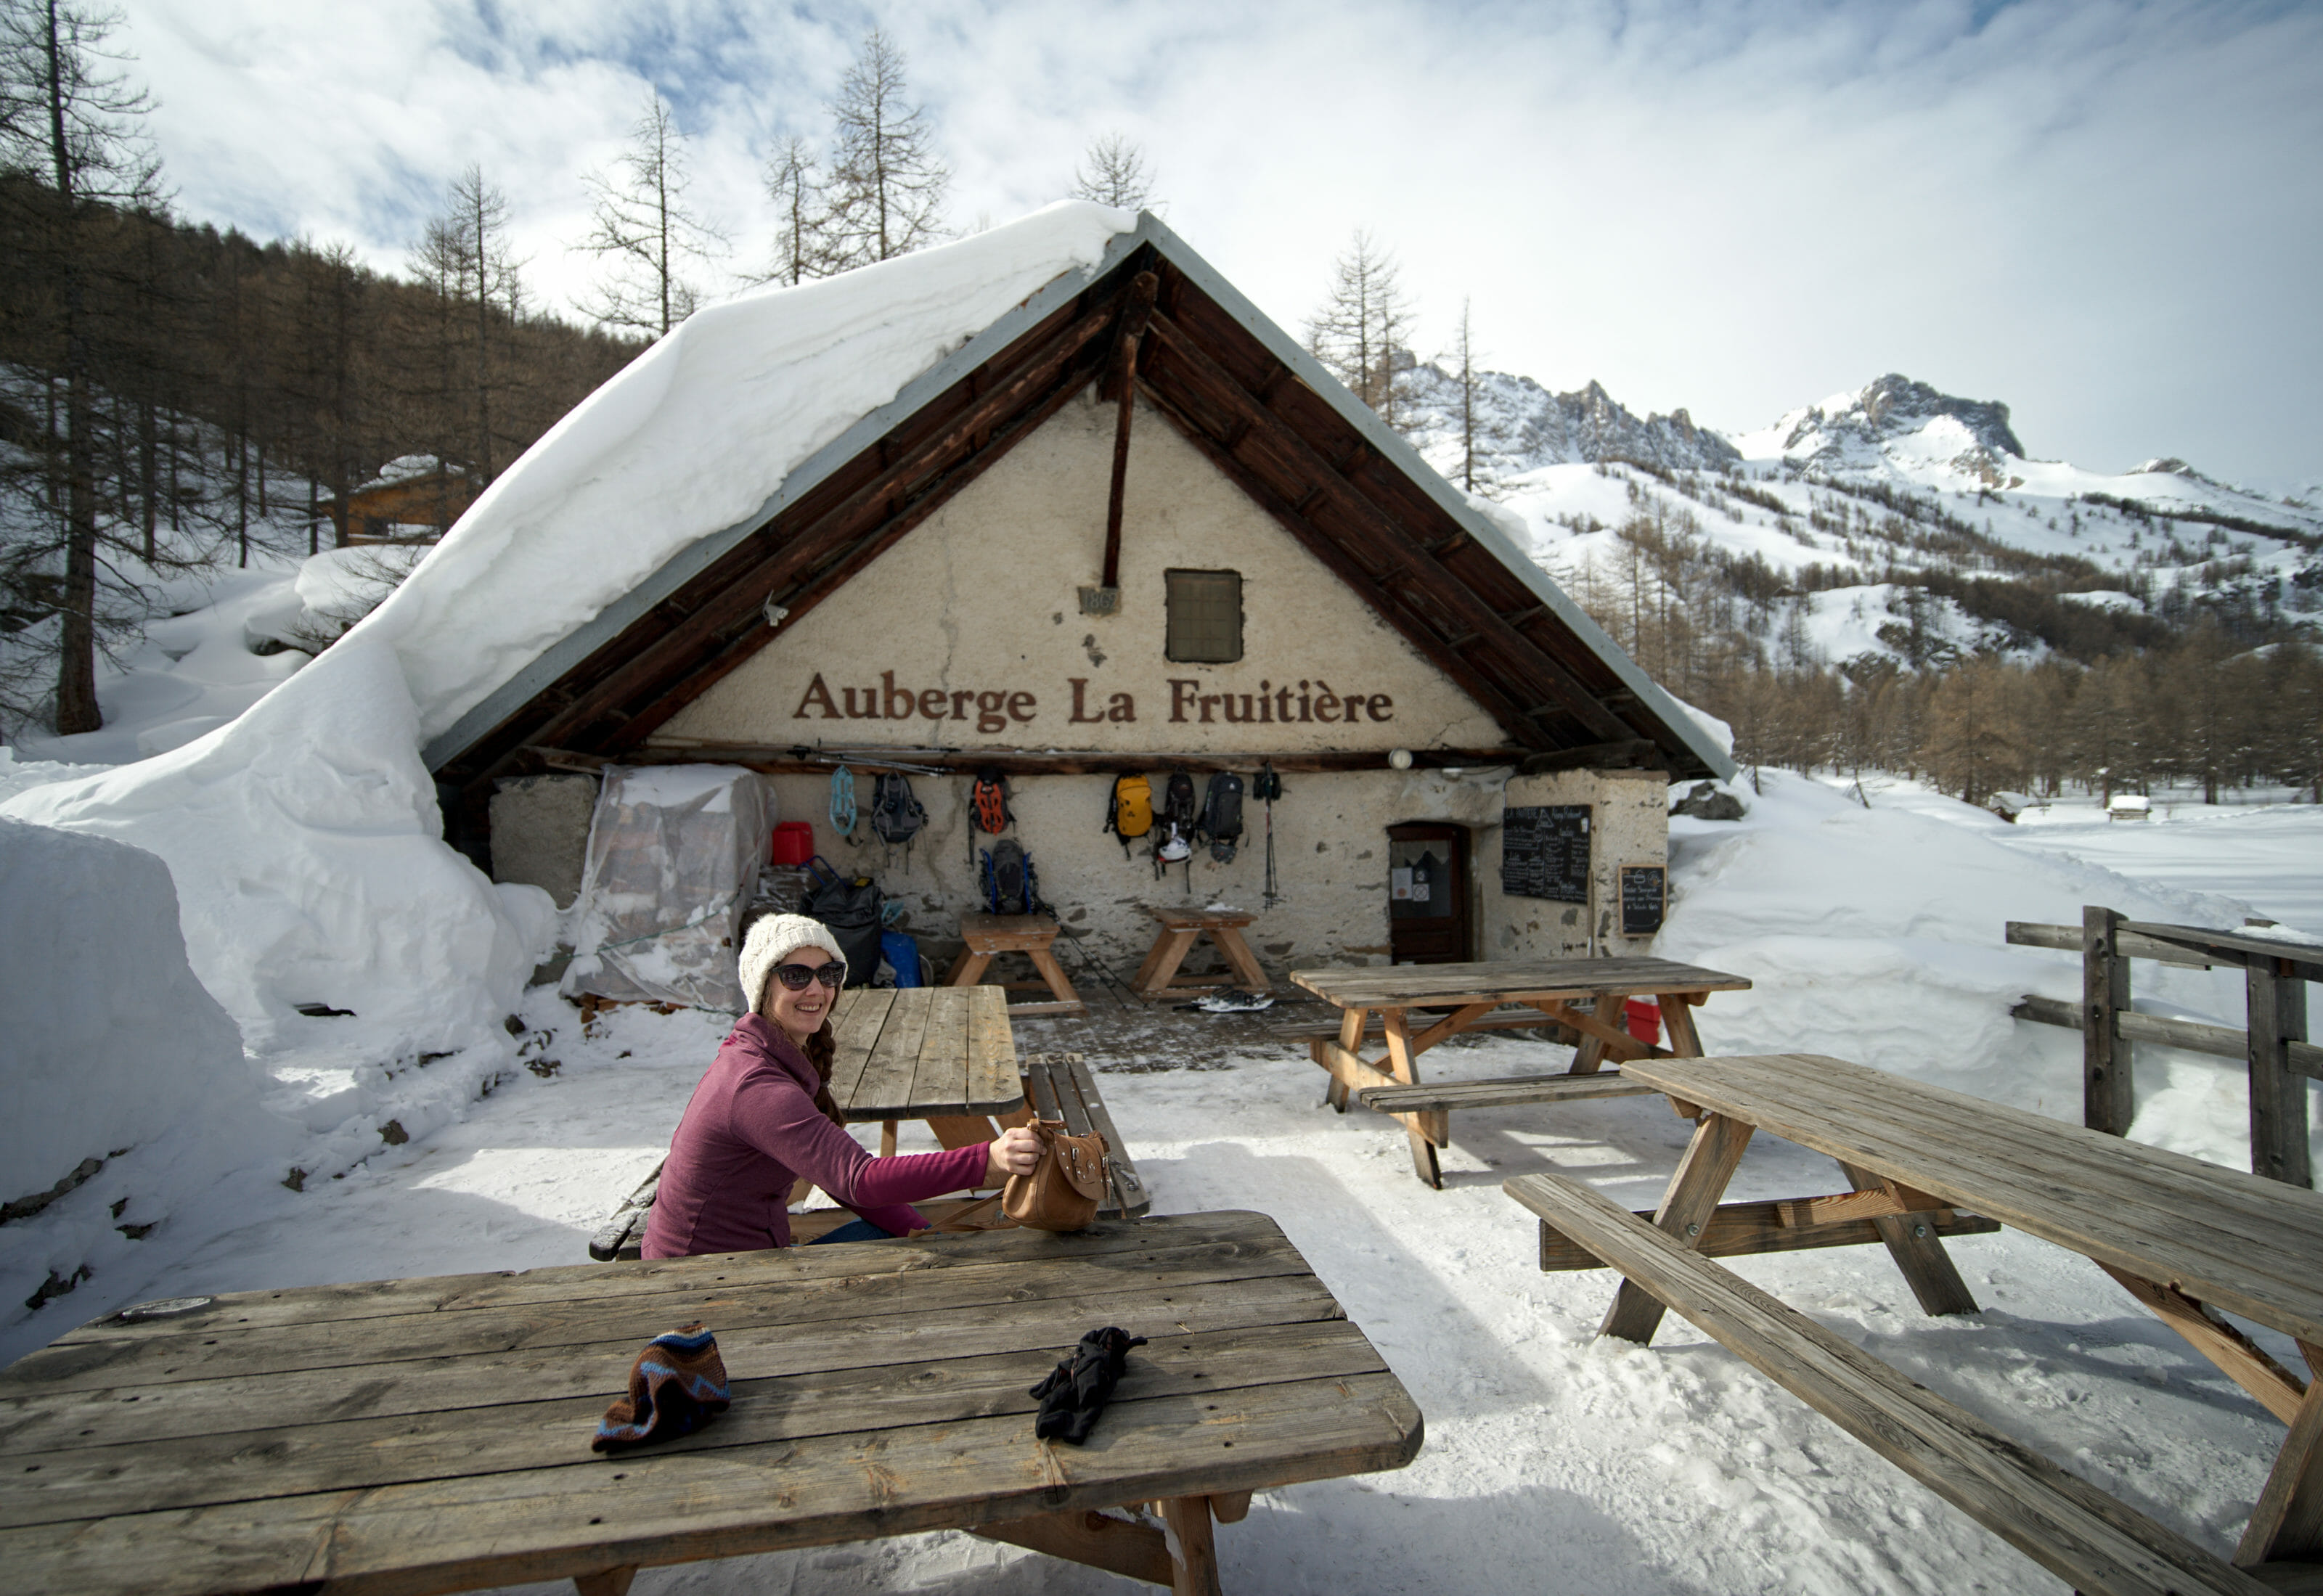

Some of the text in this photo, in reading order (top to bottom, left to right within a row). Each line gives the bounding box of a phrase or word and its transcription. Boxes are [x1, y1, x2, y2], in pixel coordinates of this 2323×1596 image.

[792, 671, 1395, 734] Auberge La Fruitière
